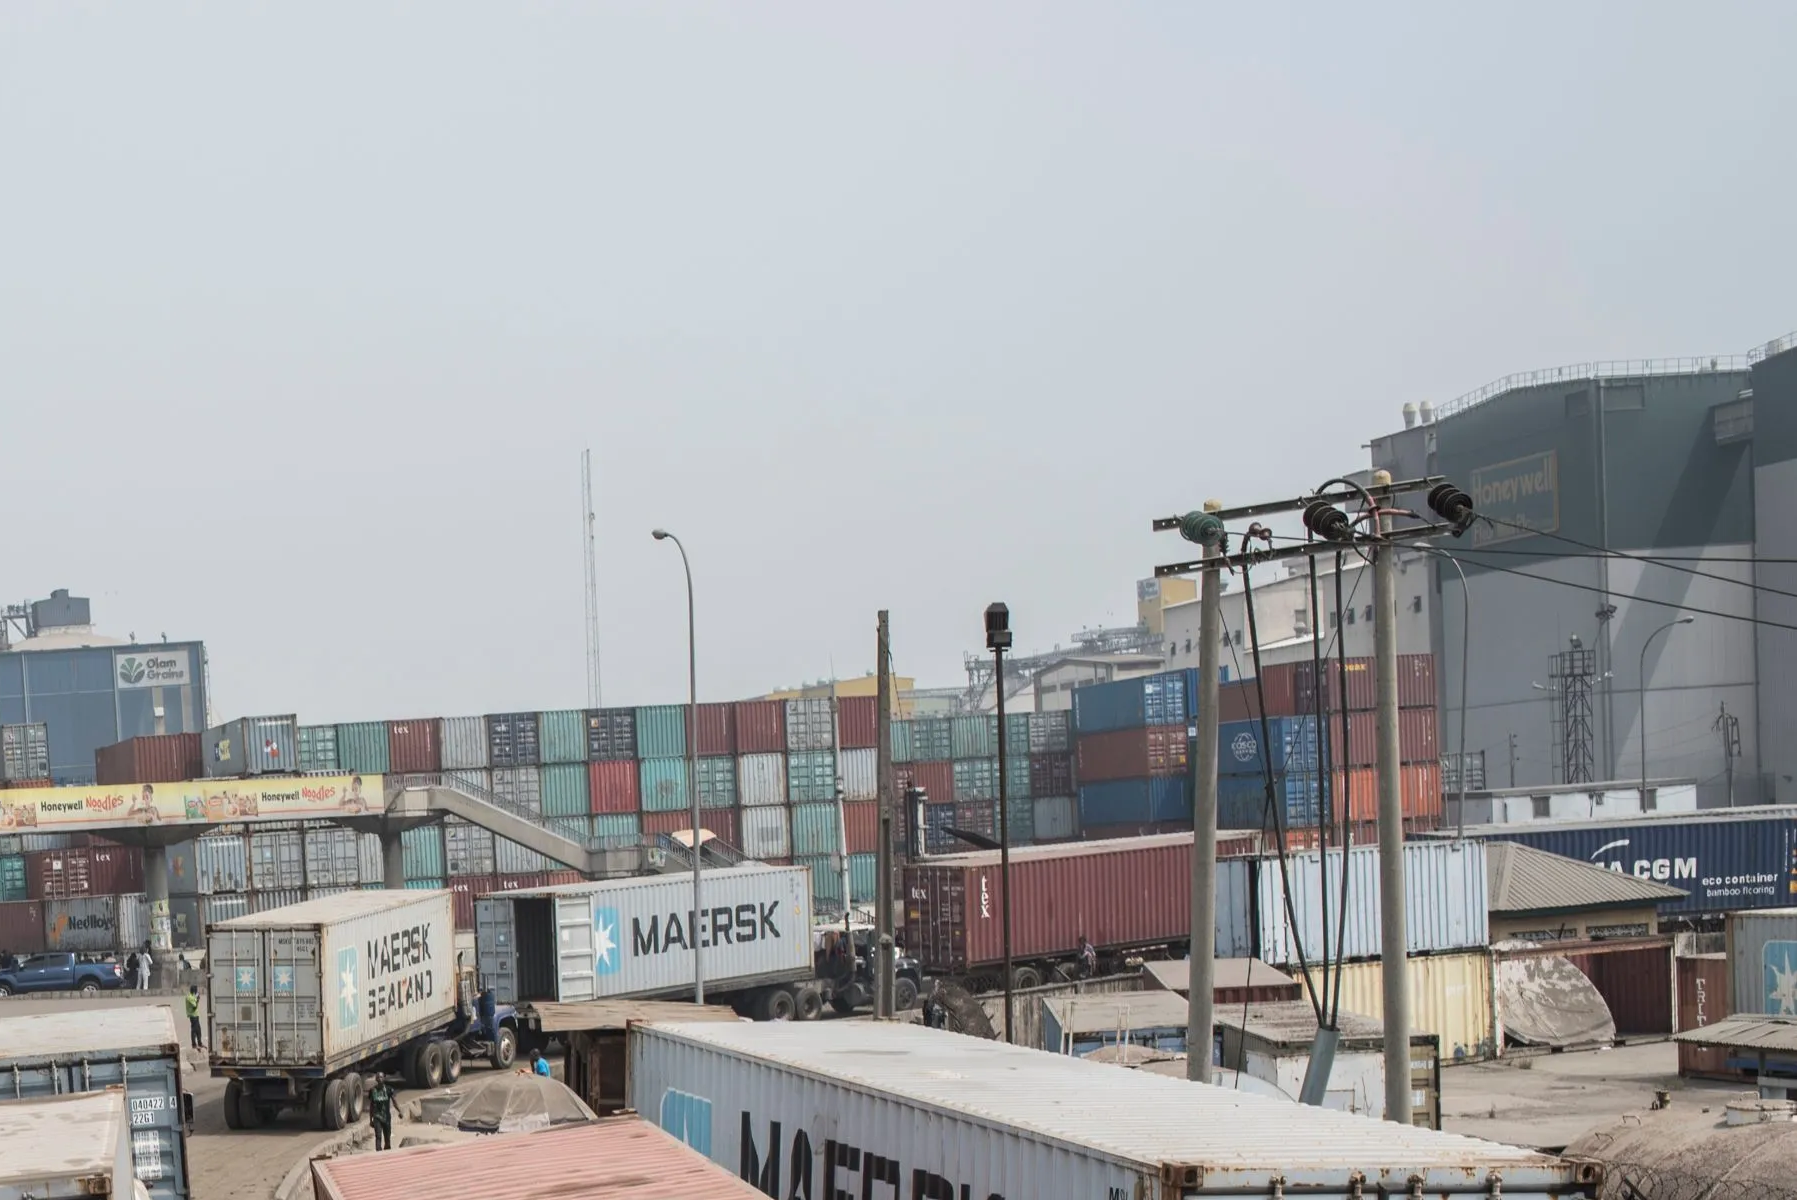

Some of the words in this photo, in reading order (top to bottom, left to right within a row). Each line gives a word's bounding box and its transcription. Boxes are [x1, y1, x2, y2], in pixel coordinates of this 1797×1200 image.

[1473, 457, 1552, 507] Honeywell
[146, 656, 176, 669] Olam
[147, 668, 184, 680] Grains
[394, 724, 409, 734] tex
[261, 791, 300, 802] Honeywell
[302, 785, 336, 801] Noodles
[41, 800, 83, 813] Honeywell
[85, 794, 124, 810] Noodles
[95, 852, 111, 862] tex
[1633, 856, 1697, 880] CGM
[504, 880, 519, 889] tex
[1702, 877, 1722, 886] eco
[1725, 872, 1778, 884] container
[453, 883, 469, 892] tex
[911, 887, 927, 899] tex
[1706, 886, 1740, 897] bamboo
[1742, 885, 1775, 896] flooring
[981, 875, 991, 918] tex
[632, 901, 781, 957] MAERSK
[367, 922, 432, 980] MAERSK
[368, 969, 433, 1020] SEALAND
[132, 1098, 164, 1110] 040422
[172, 1097, 177, 1107] 4
[134, 1112, 154, 1124] 22G1
